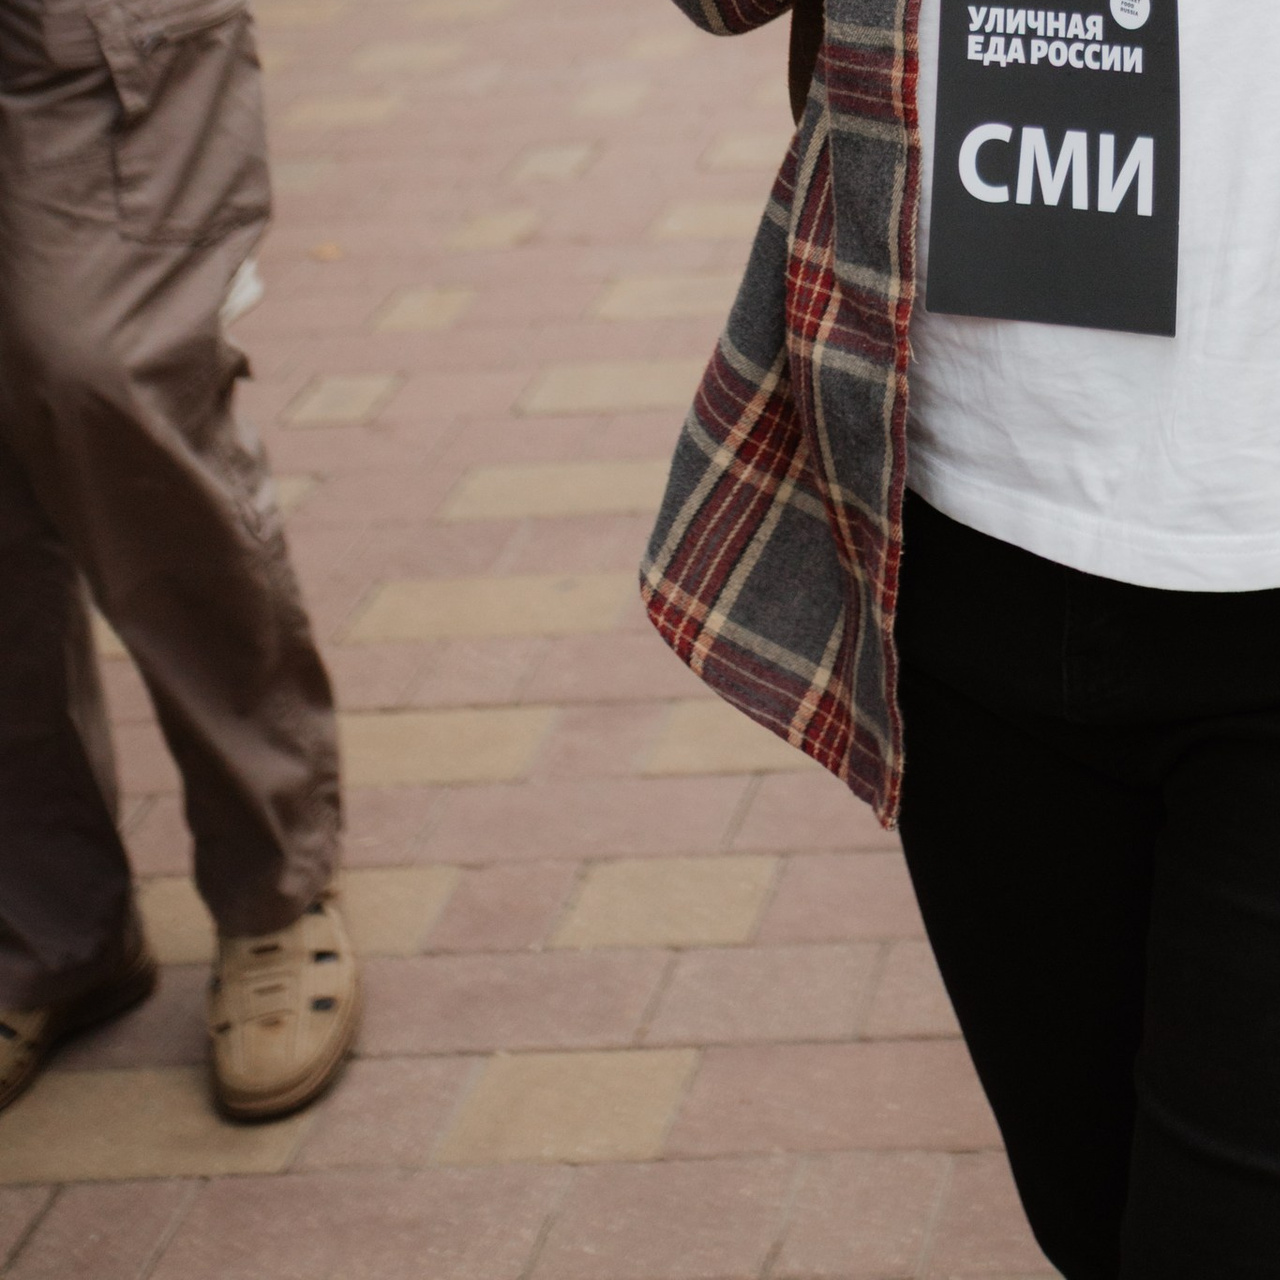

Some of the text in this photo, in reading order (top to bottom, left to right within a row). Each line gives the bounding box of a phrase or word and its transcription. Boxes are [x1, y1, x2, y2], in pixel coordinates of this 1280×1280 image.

[1120, 6, 1138, 16] RUSSIA
[1121, 0, 1135, 9] FOOD
[967, 5, 1103, 40] УЛИЧНАЯ
[967, 35, 1143, 73] ЕДА РОССИИ
[958, 122, 1154, 217] СМИ
